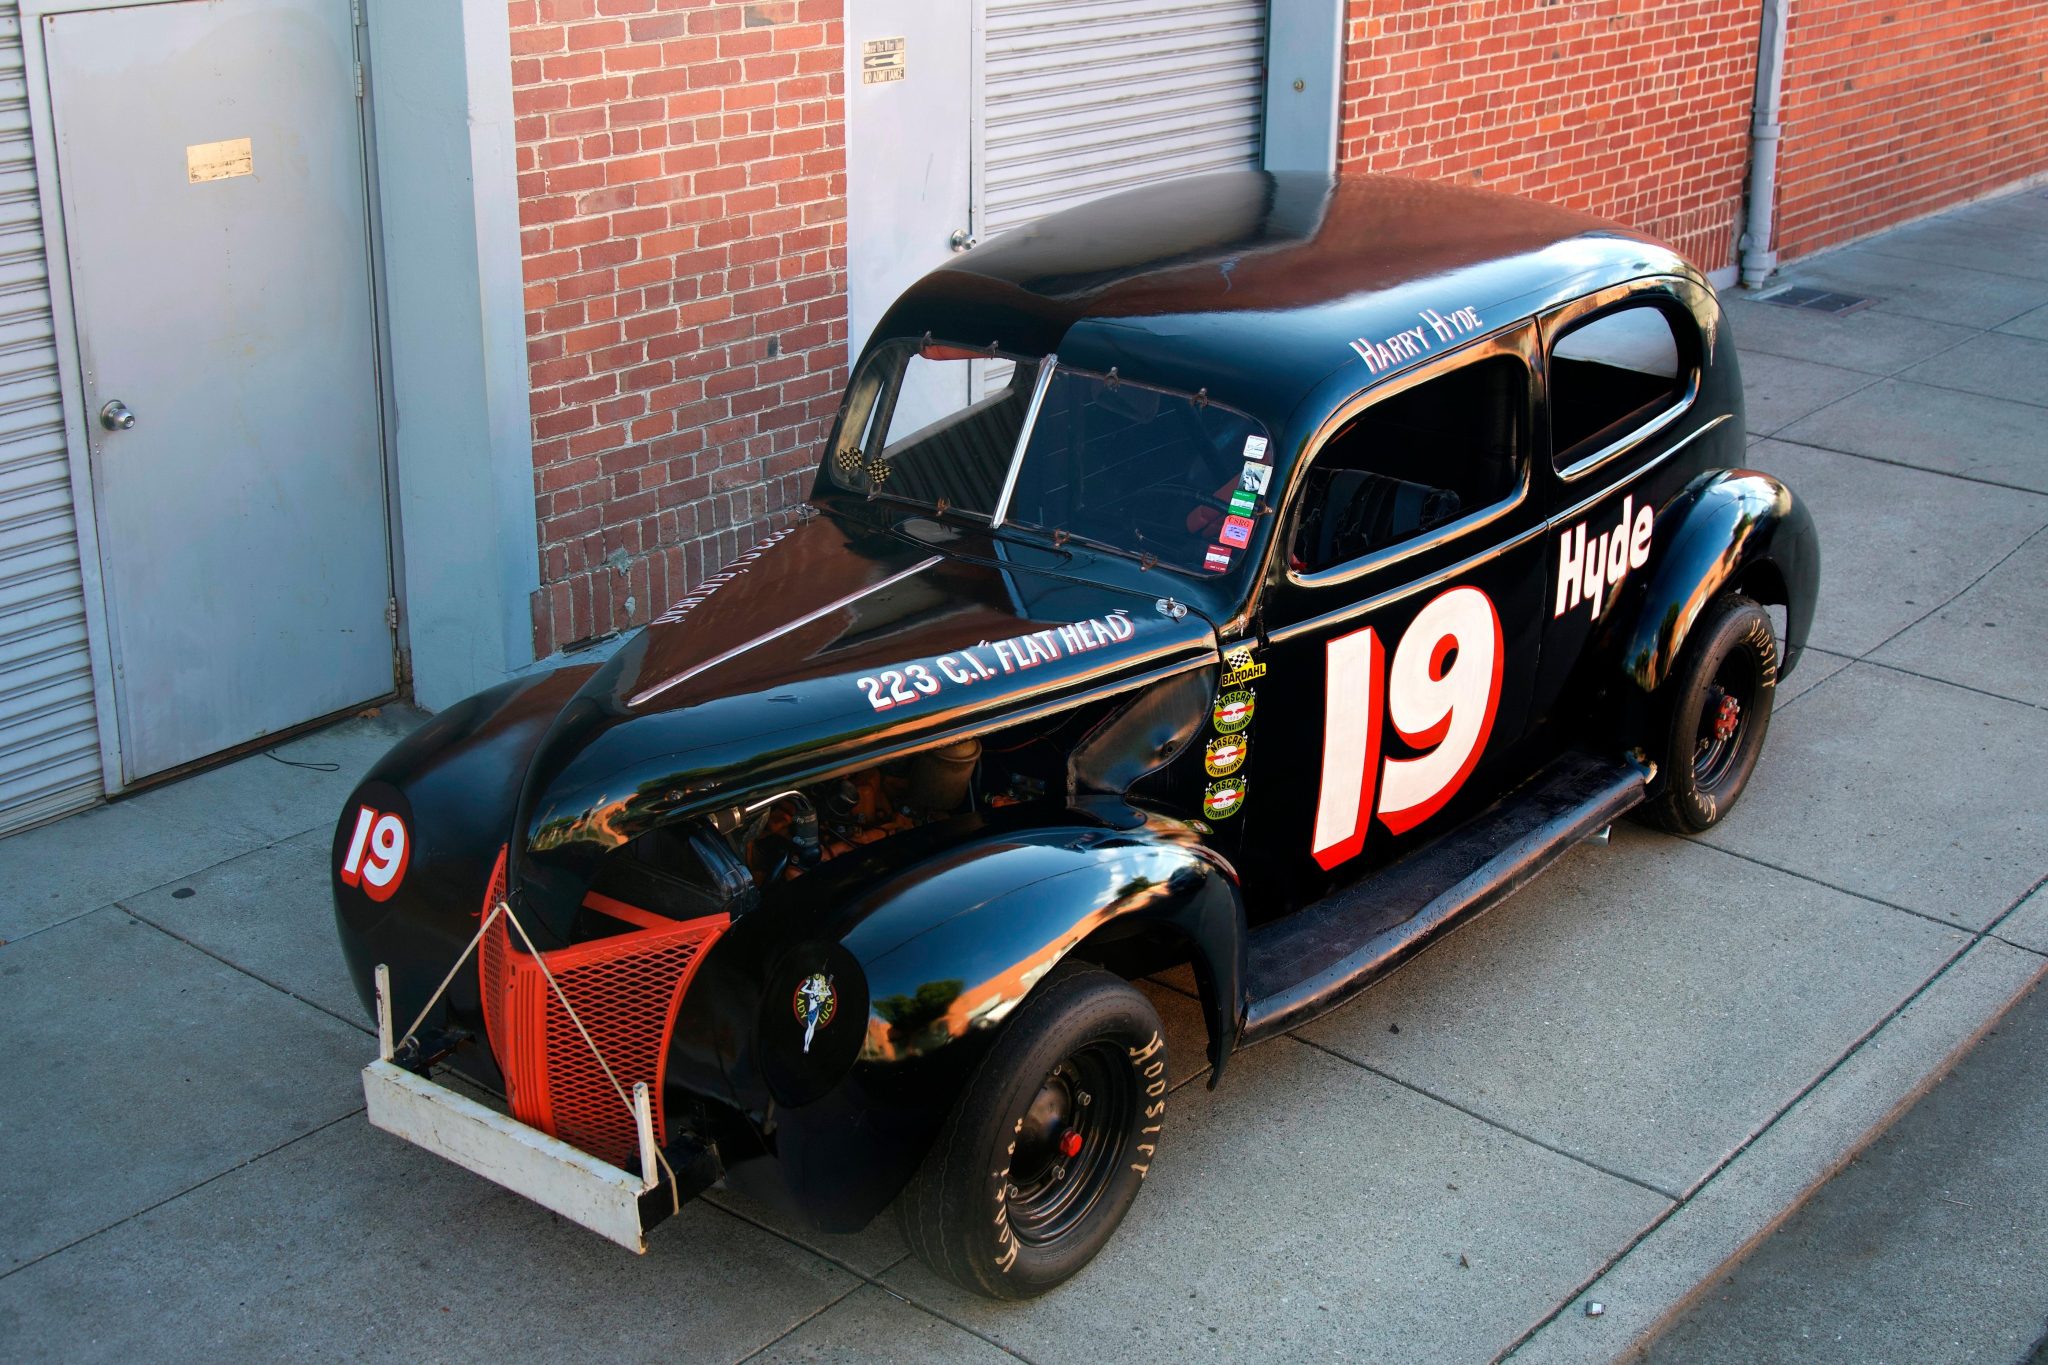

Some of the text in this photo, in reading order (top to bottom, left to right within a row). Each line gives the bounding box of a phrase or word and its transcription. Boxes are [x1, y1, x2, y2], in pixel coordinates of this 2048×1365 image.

[1349, 305, 1484, 374] HARRY HYDE
[1554, 494, 1654, 621] Hyde
[856, 664, 941, 712] 223
[936, 651, 998, 686] C.I.
[1222, 664, 1266, 685] BARDAHL
[1218, 691, 1251, 709] NASCAR
[1215, 714, 1251, 731] INTERNATIONAL
[1311, 585, 1504, 871] 19
[1209, 735, 1243, 753] NASCAR
[1207, 757, 1243, 776] INTERNATIONAL
[1210, 779, 1242, 797] NASCAR
[1206, 801, 1242, 818] INTERNATIONAL
[341, 804, 410, 902] 19
[797, 991, 835, 1024] LADY LUCK
